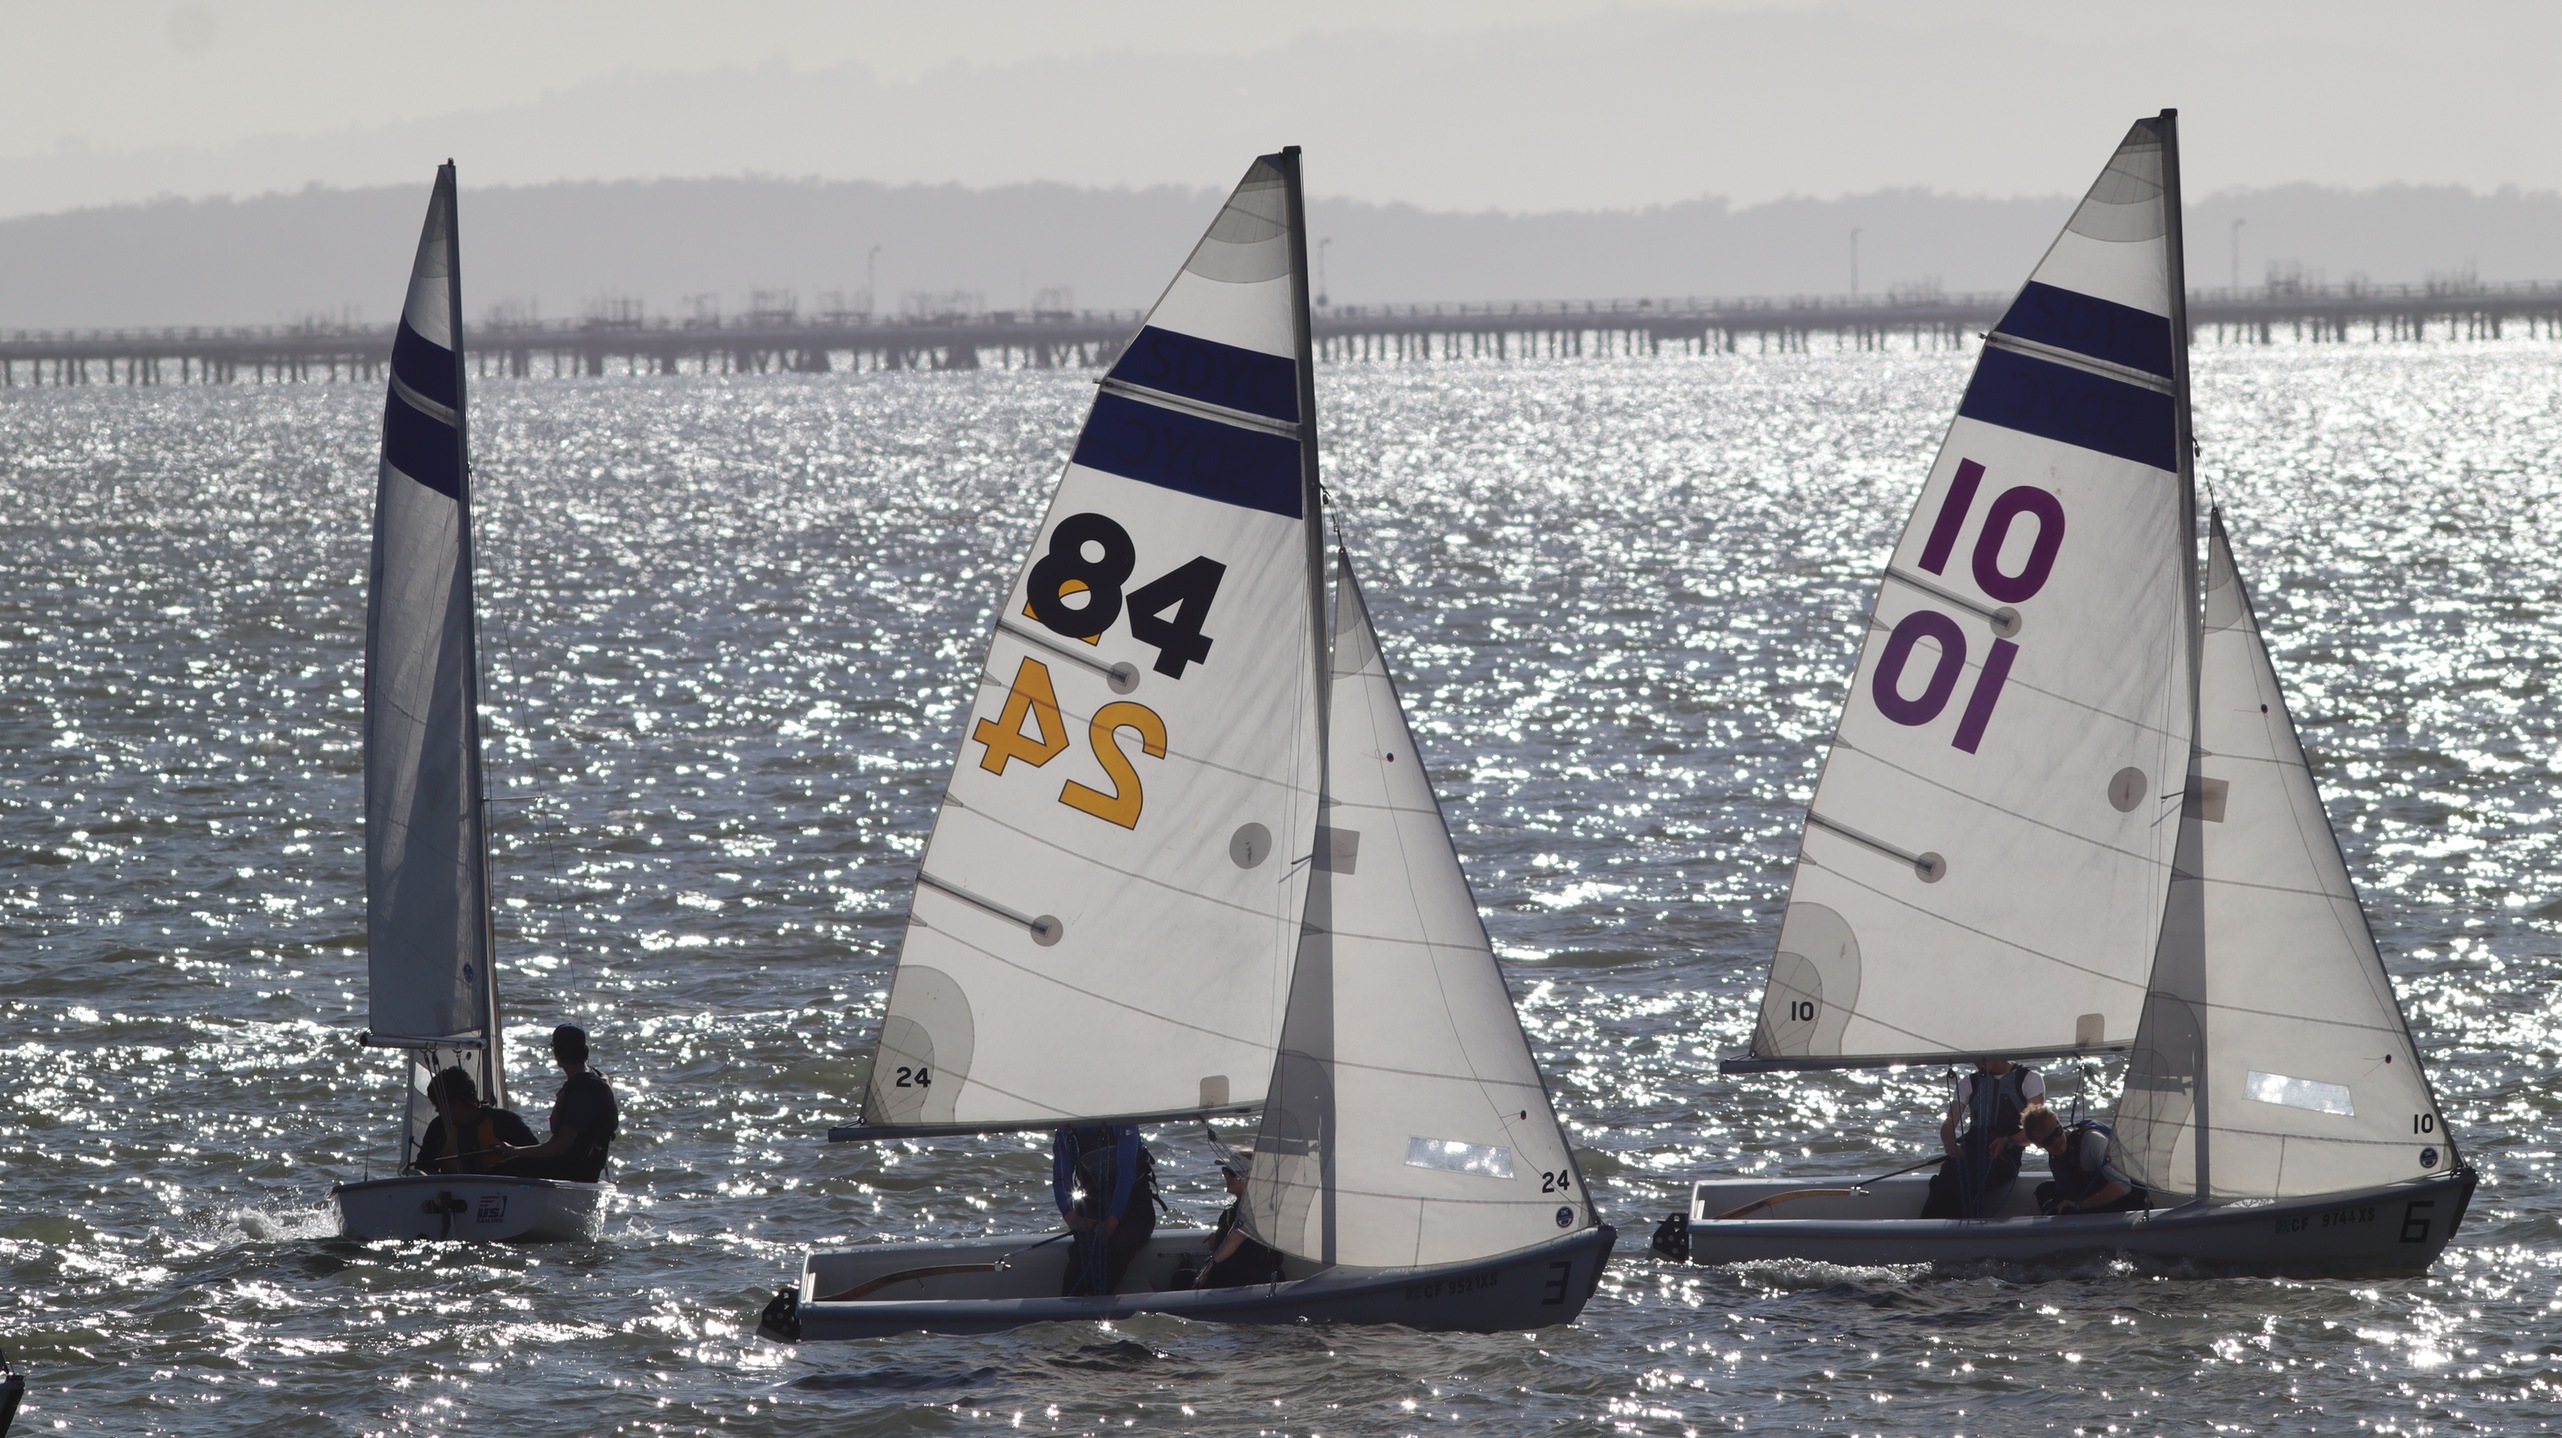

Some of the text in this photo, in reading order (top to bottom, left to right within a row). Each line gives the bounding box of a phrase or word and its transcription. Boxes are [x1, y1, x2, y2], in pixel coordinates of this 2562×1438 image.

[1142, 335, 1282, 408] SDYC
[1918, 457, 2066, 604] 10
[1027, 512, 1227, 680] 84
[1791, 1001, 1814, 1021] 10
[895, 1066, 931, 1088] 24
[2413, 1113, 2434, 1135] 10
[1541, 1169, 1570, 1193] 24
[2290, 1216, 2310, 1232] CF
[2398, 1200, 2435, 1244] 6
[1423, 1283, 1443, 1299] CF
[1541, 1261, 1572, 1305] 3
